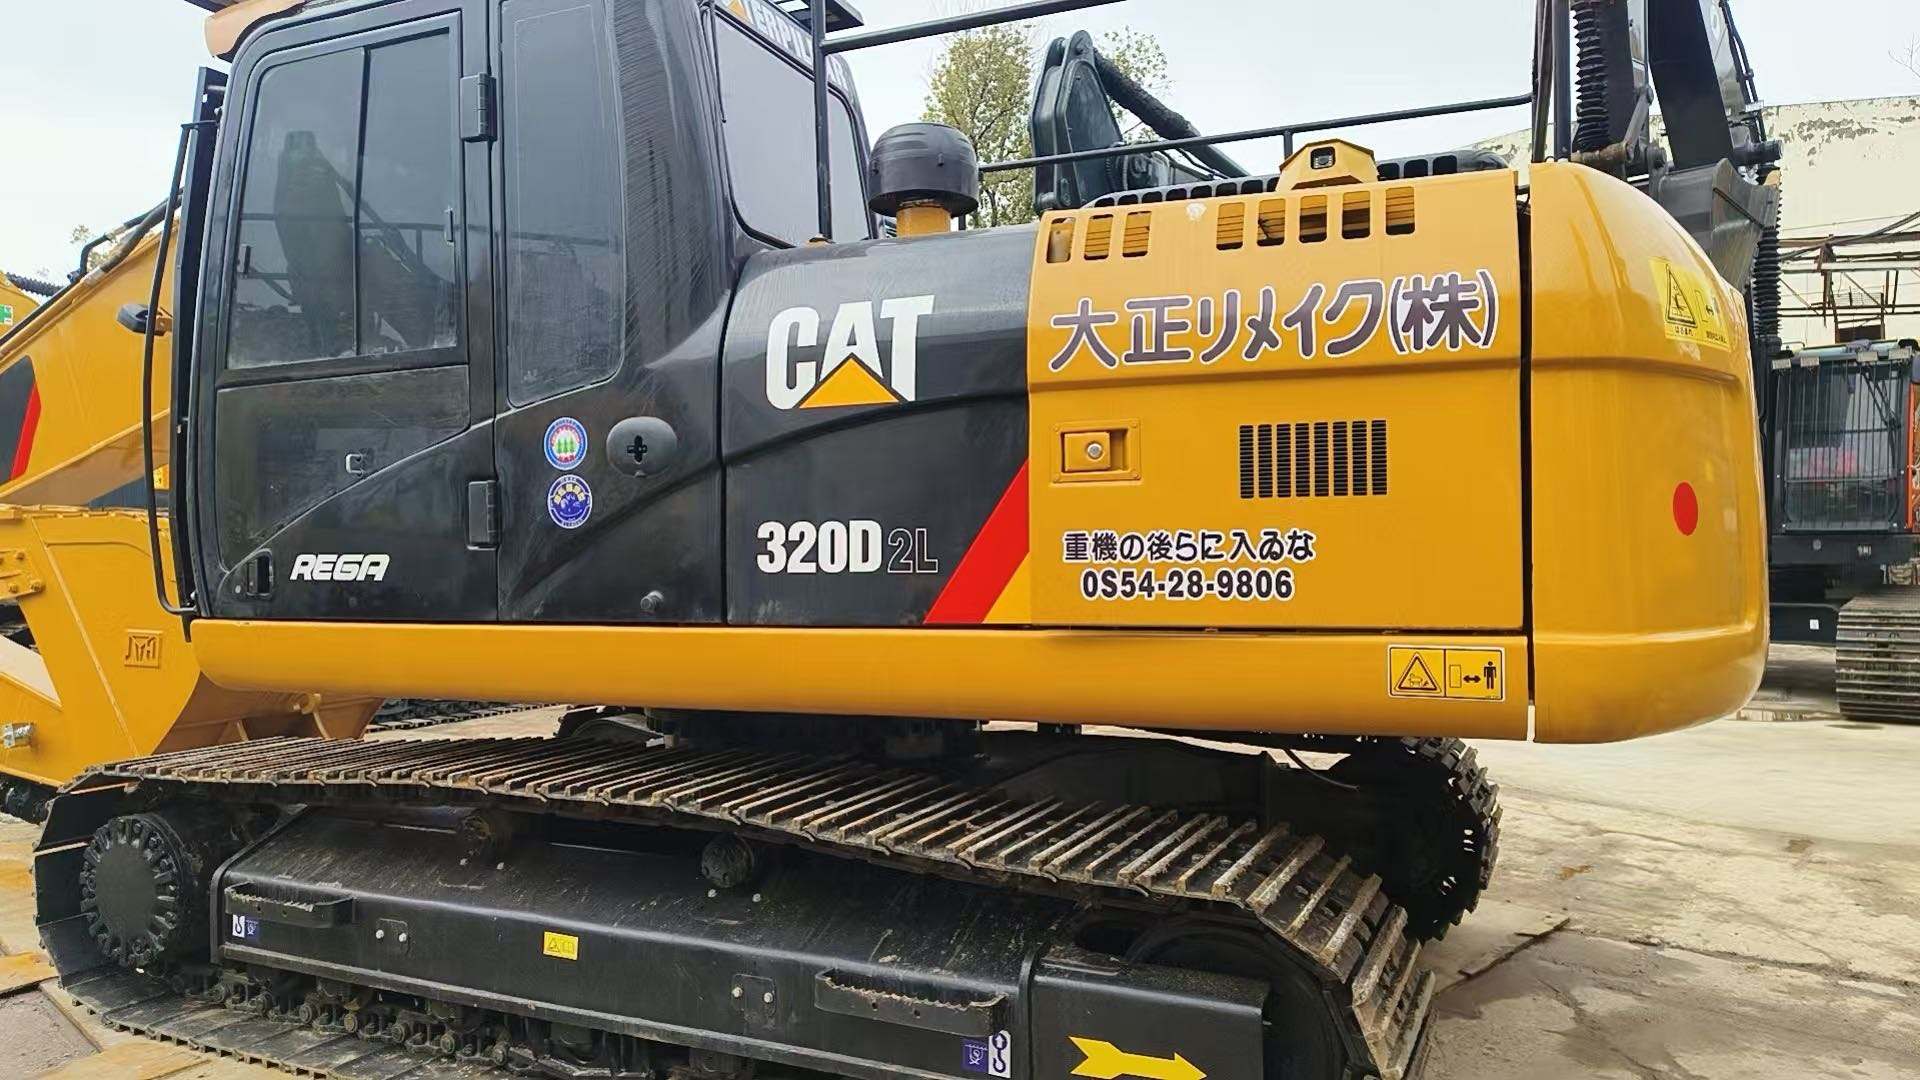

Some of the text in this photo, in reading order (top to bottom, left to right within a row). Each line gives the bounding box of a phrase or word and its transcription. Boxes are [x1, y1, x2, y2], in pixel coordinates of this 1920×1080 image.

[766, 295, 935, 410] CAT
[1048, 269, 1500, 372] 大正リメイク(株)
[289, 554, 390, 581] REGA
[757, 520, 939, 573] 320D 2L
